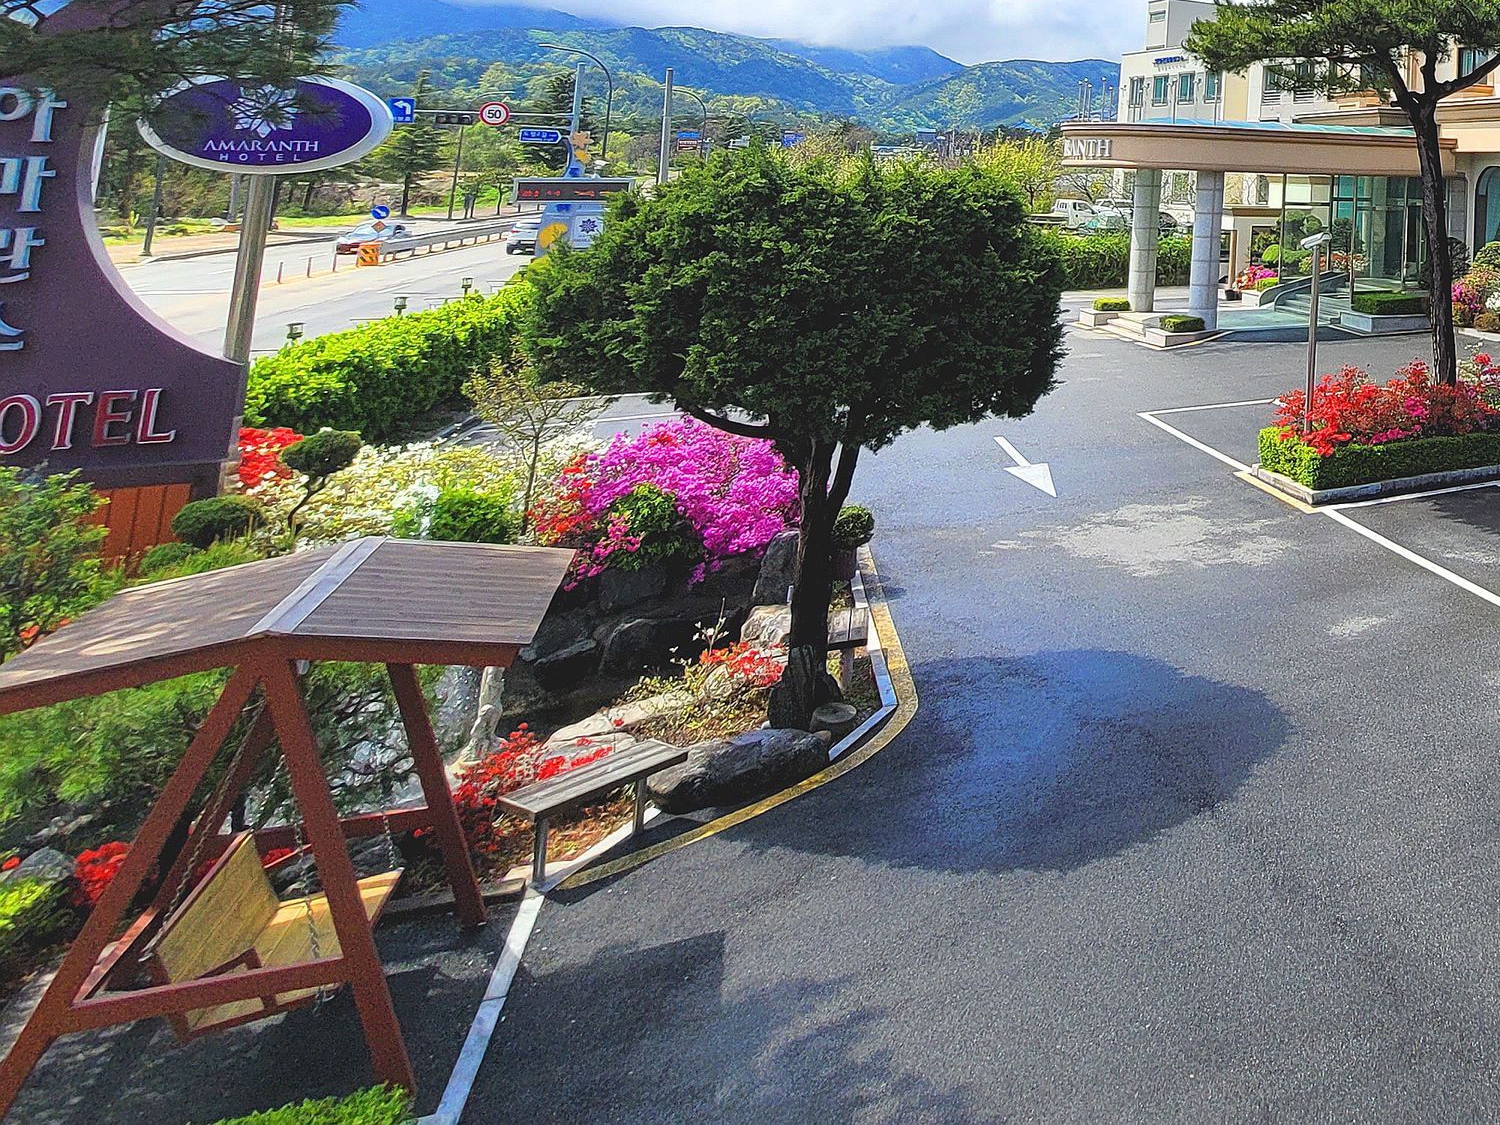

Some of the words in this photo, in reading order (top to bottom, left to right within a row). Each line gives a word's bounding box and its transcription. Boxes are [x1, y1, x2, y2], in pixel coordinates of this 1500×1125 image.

[486, 109, 502, 119] 50
[203, 139, 319, 152] AMARANTH
[220, 153, 302, 162] HOTEL
